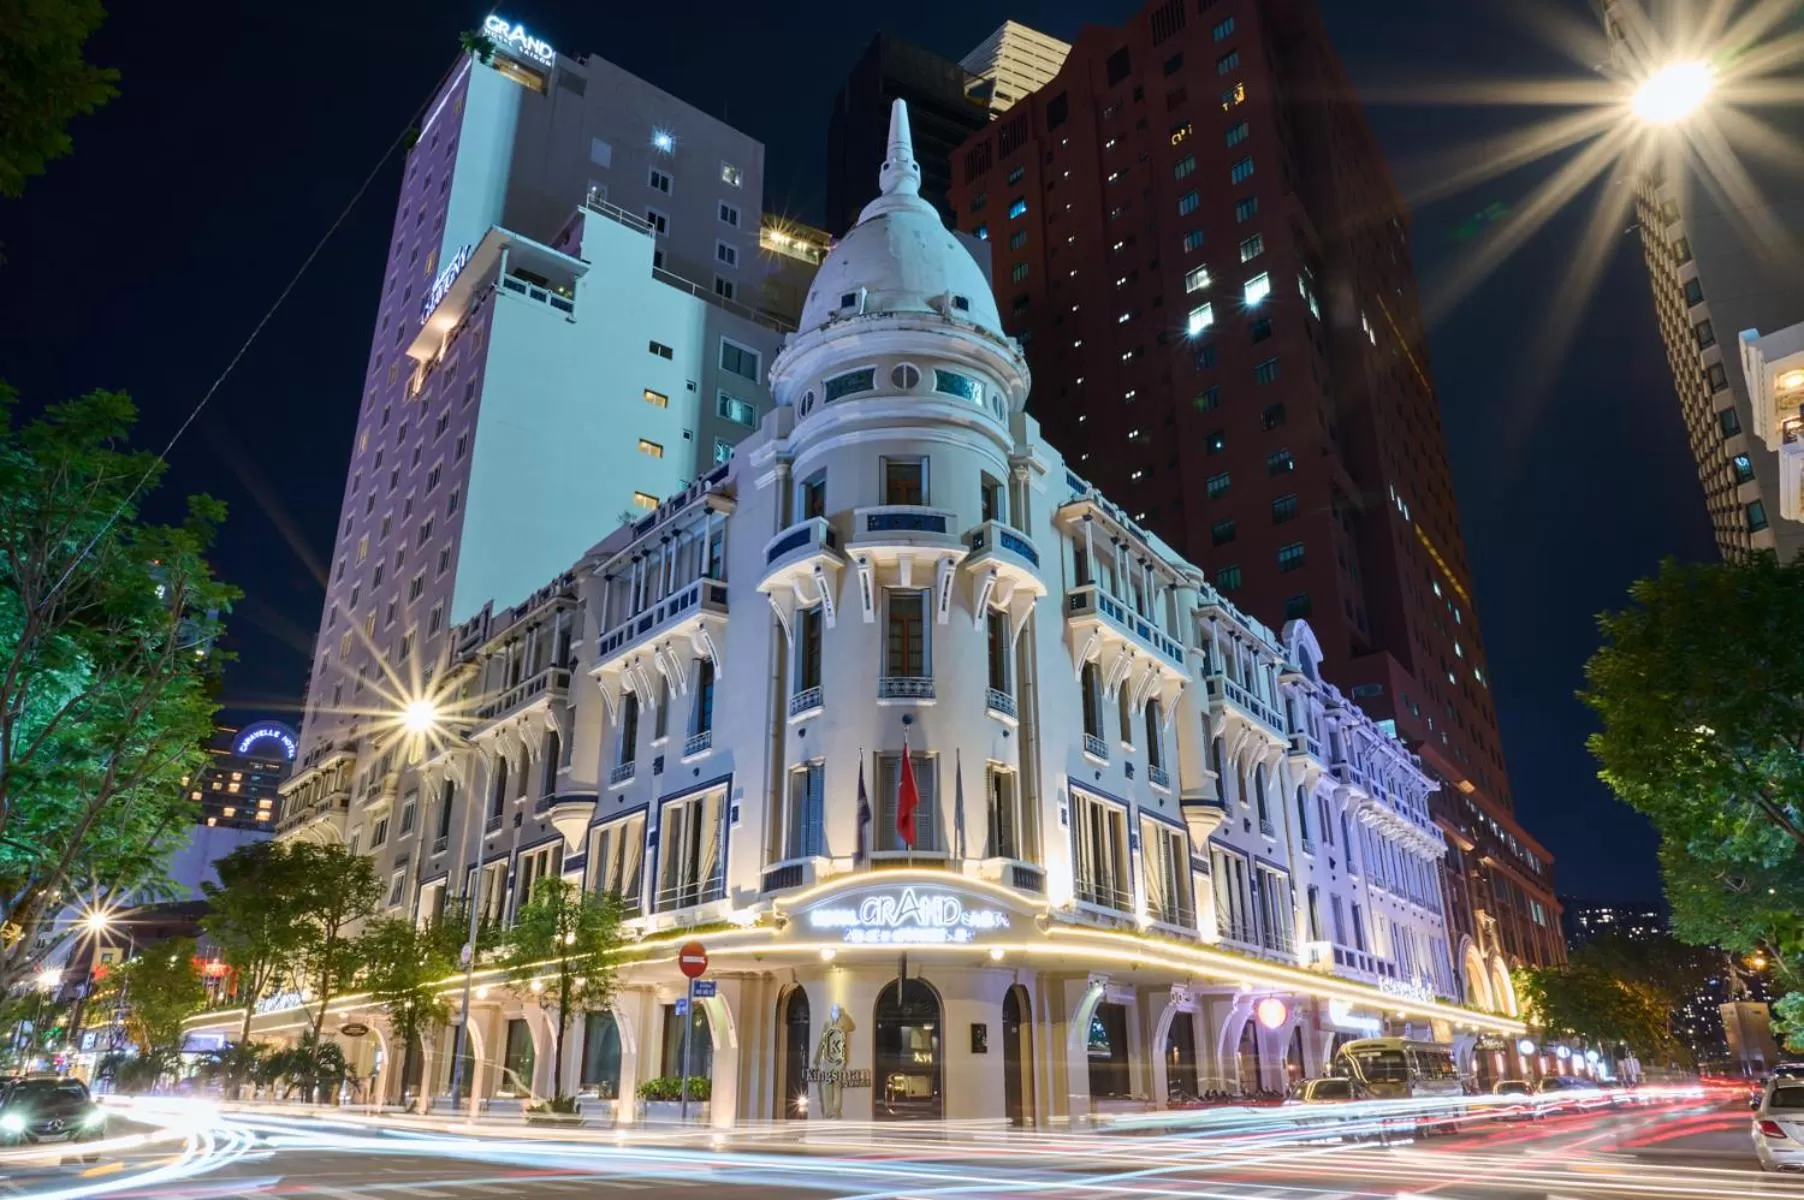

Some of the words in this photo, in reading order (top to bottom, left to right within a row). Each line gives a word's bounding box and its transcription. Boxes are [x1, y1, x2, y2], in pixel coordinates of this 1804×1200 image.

[484, 14, 553, 59] GRAND
[239, 729, 281, 752] CARAVELLE
[860, 887, 962, 928] GRAND
